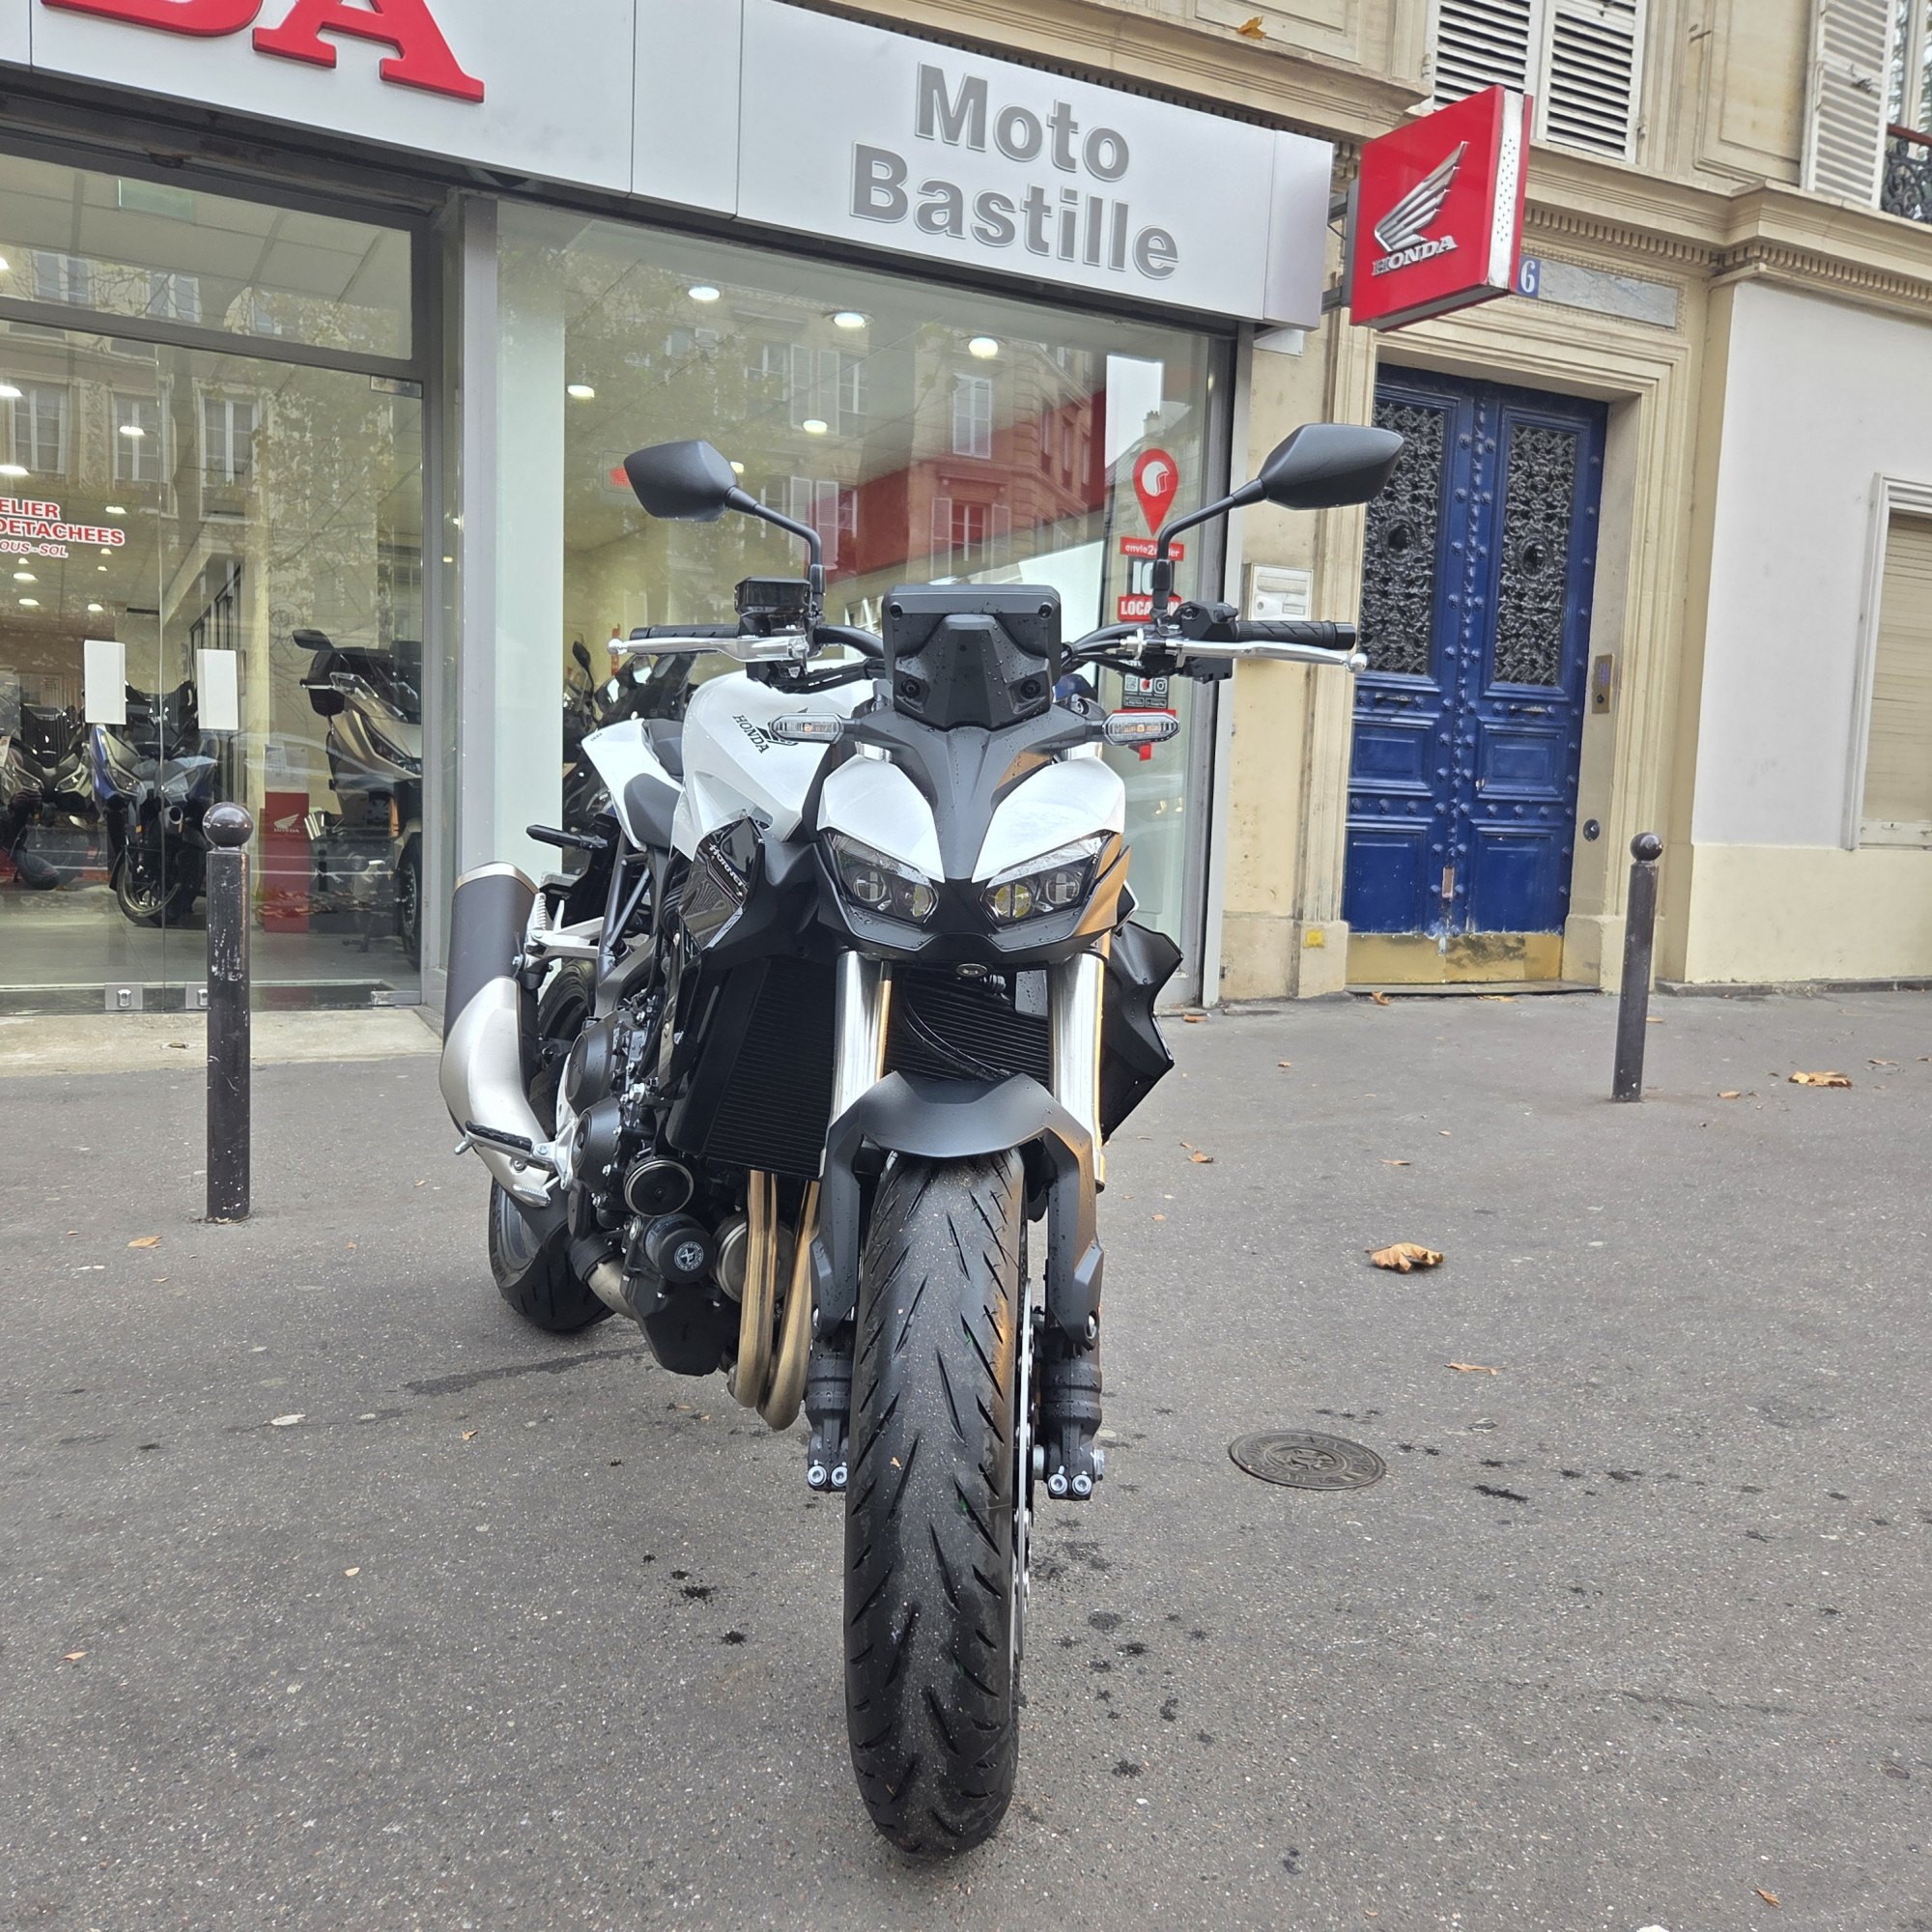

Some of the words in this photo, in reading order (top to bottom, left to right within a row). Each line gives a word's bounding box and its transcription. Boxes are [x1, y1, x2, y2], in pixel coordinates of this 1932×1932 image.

[915, 61, 1129, 182] Moto
[850, 141, 1179, 279] Bastille
[1372, 235, 1459, 276] HONDA
[1520, 260, 1536, 294] 6
[732, 714, 770, 753] HONDA
[709, 842, 746, 888] HORNET
